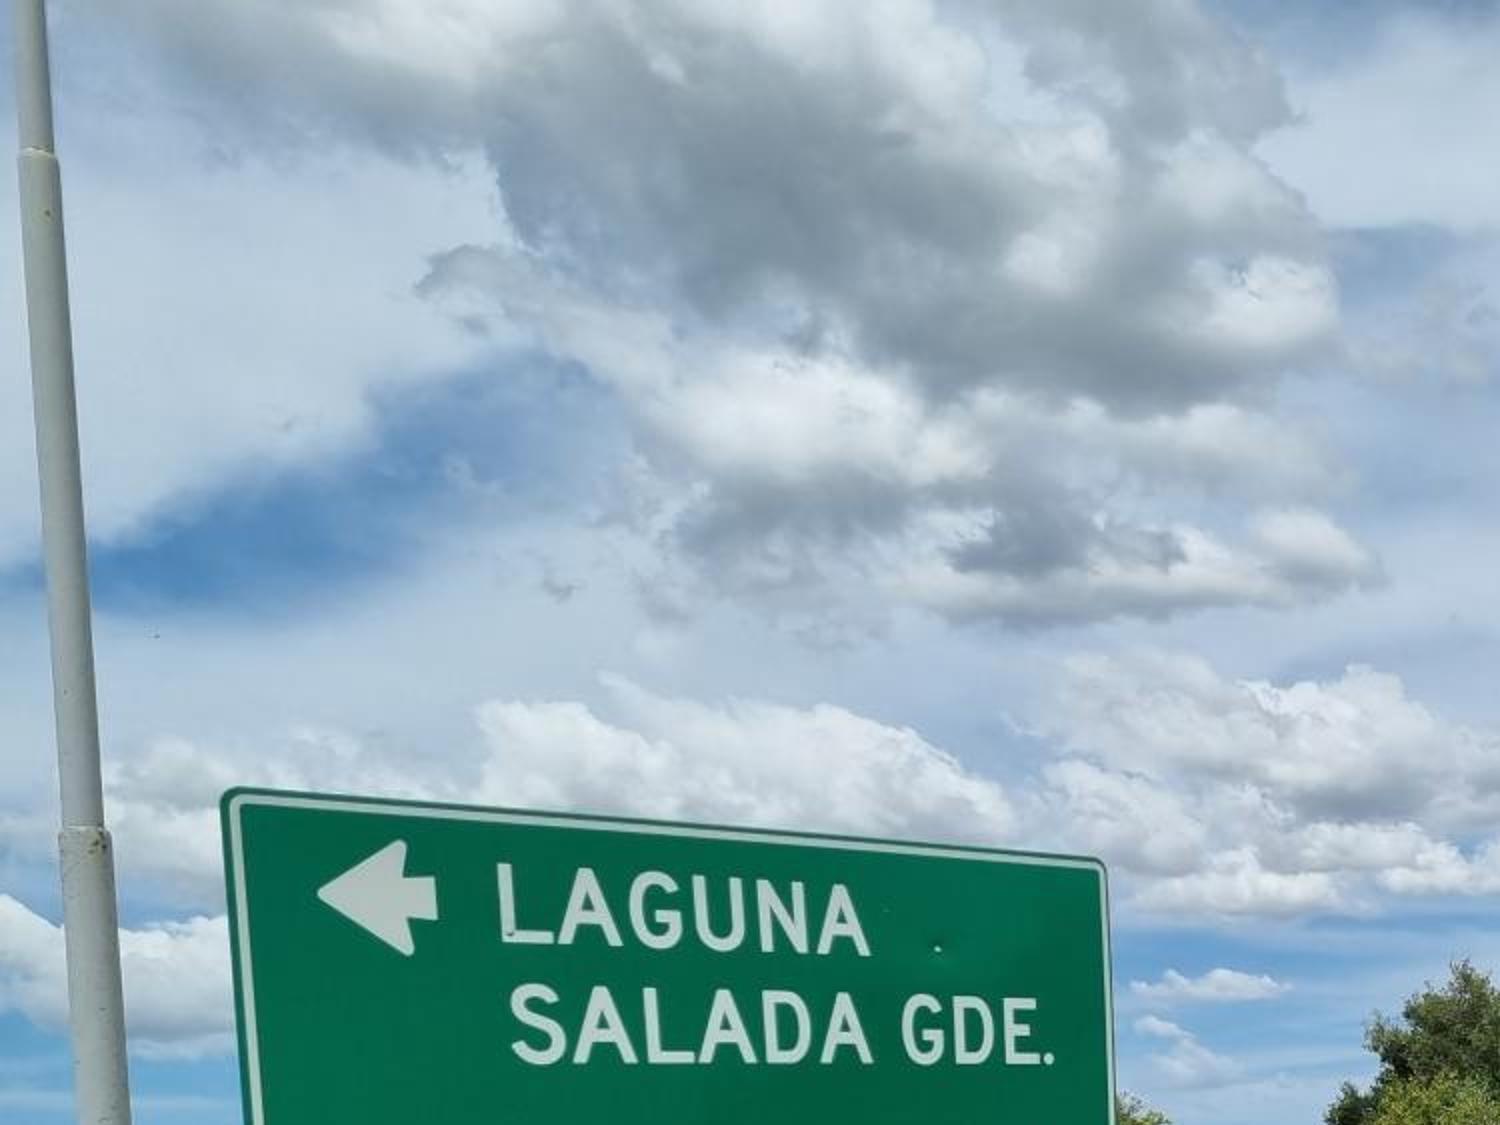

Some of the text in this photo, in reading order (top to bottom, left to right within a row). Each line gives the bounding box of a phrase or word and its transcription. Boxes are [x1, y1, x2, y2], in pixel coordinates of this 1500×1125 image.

[497, 863, 871, 957] LAGUNA
[510, 983, 1055, 1065] SALADA GDE.
